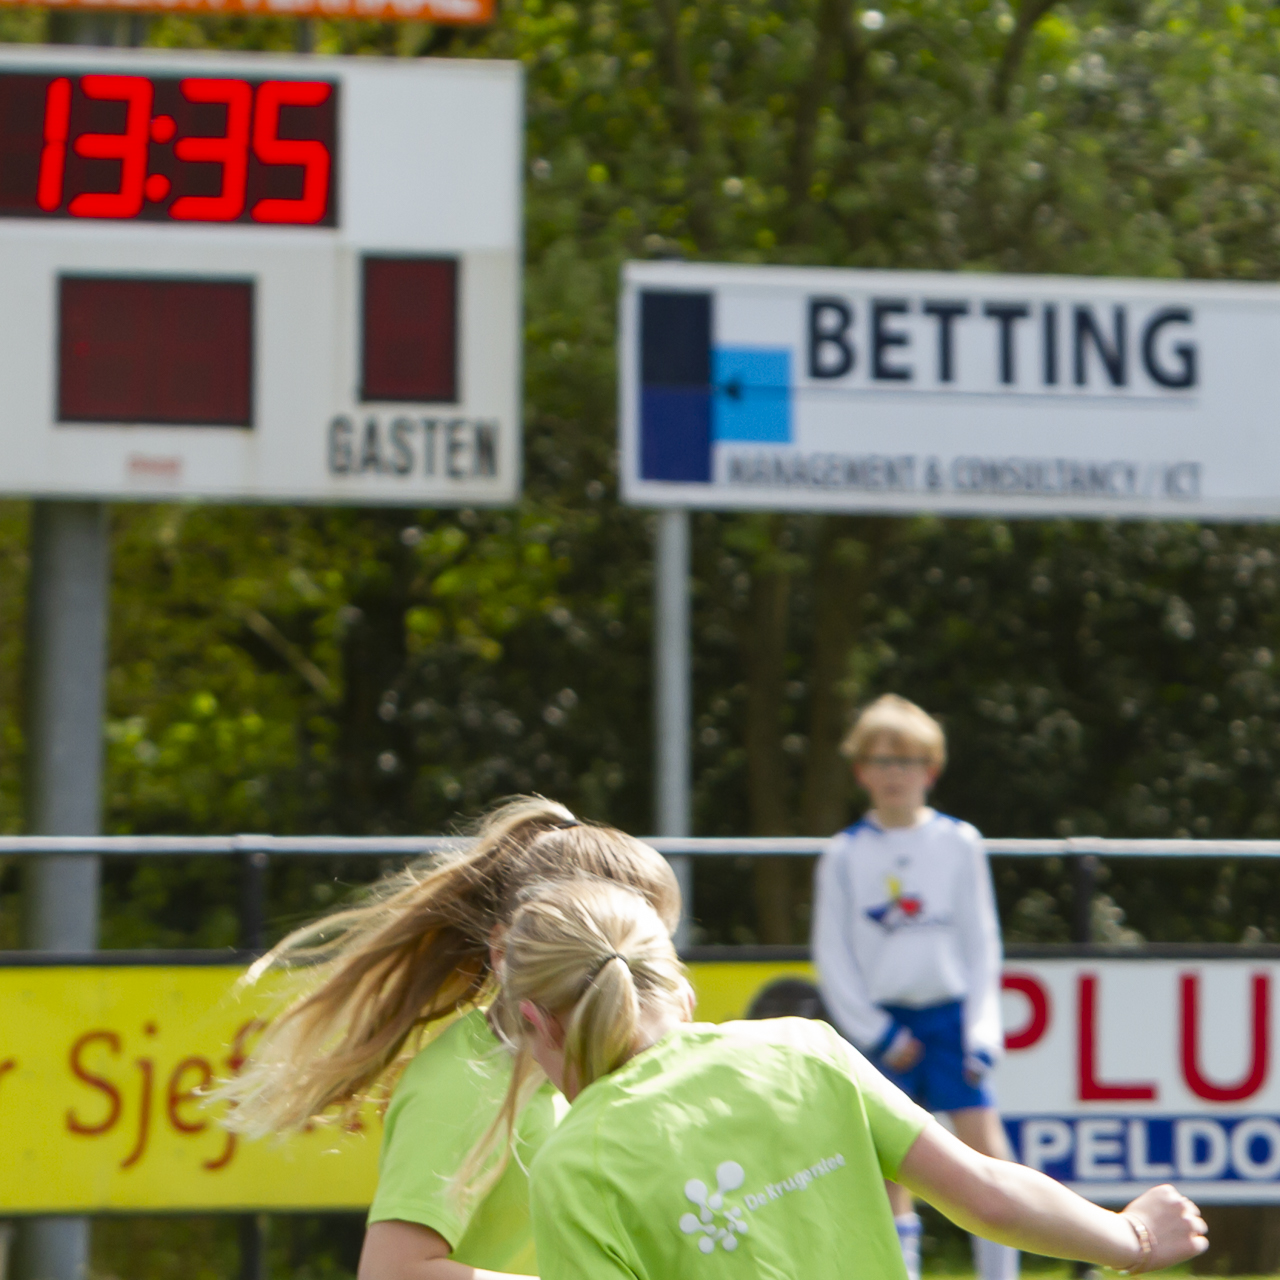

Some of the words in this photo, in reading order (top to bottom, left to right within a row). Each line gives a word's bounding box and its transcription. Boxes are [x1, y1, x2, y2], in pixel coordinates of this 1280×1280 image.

[36, 74, 333, 224] 13:35
[806, 295, 1200, 391] BETTING
[328, 414, 499, 478] GASTEN
